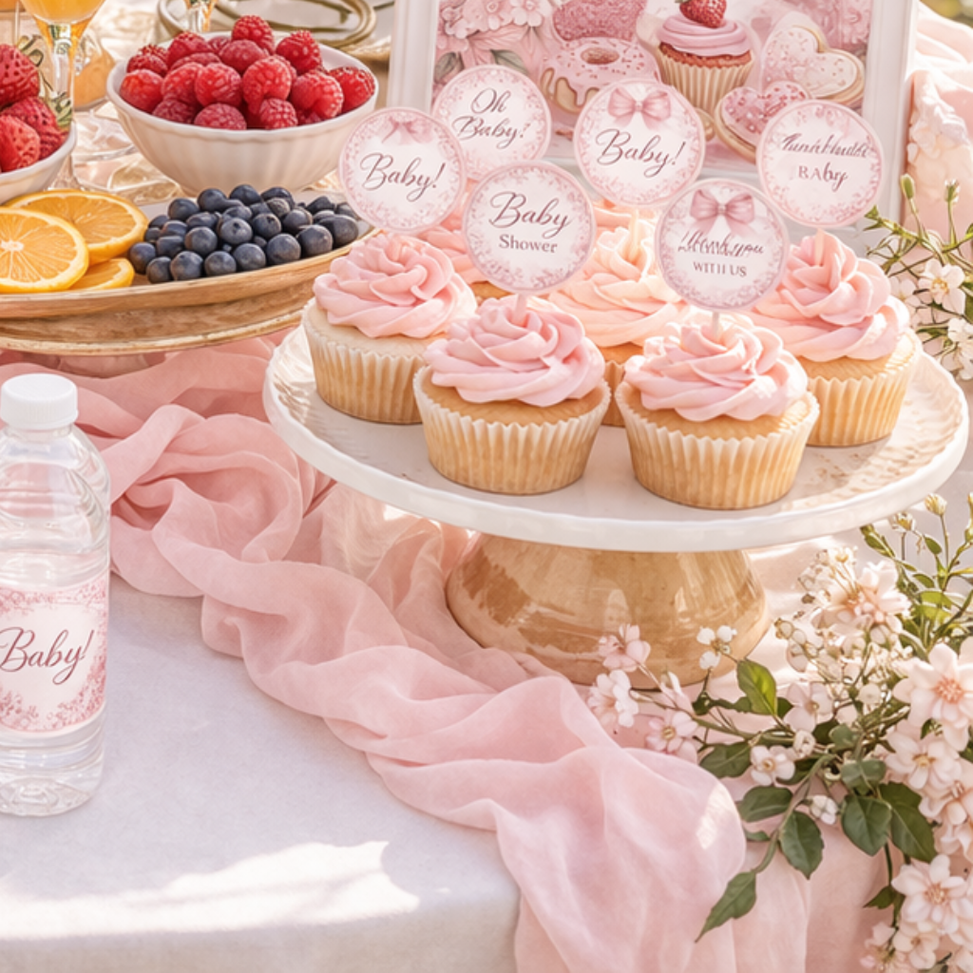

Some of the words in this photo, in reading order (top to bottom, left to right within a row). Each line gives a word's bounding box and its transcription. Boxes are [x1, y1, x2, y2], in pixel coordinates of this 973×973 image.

[471, 88, 511, 114] Oh
[595, 128, 686, 178] Baby!
[360, 153, 446, 202] Baby!
[489, 191, 570, 239] Baby
[499, 234, 558, 253] Shower
[730, 264, 747, 277] US
